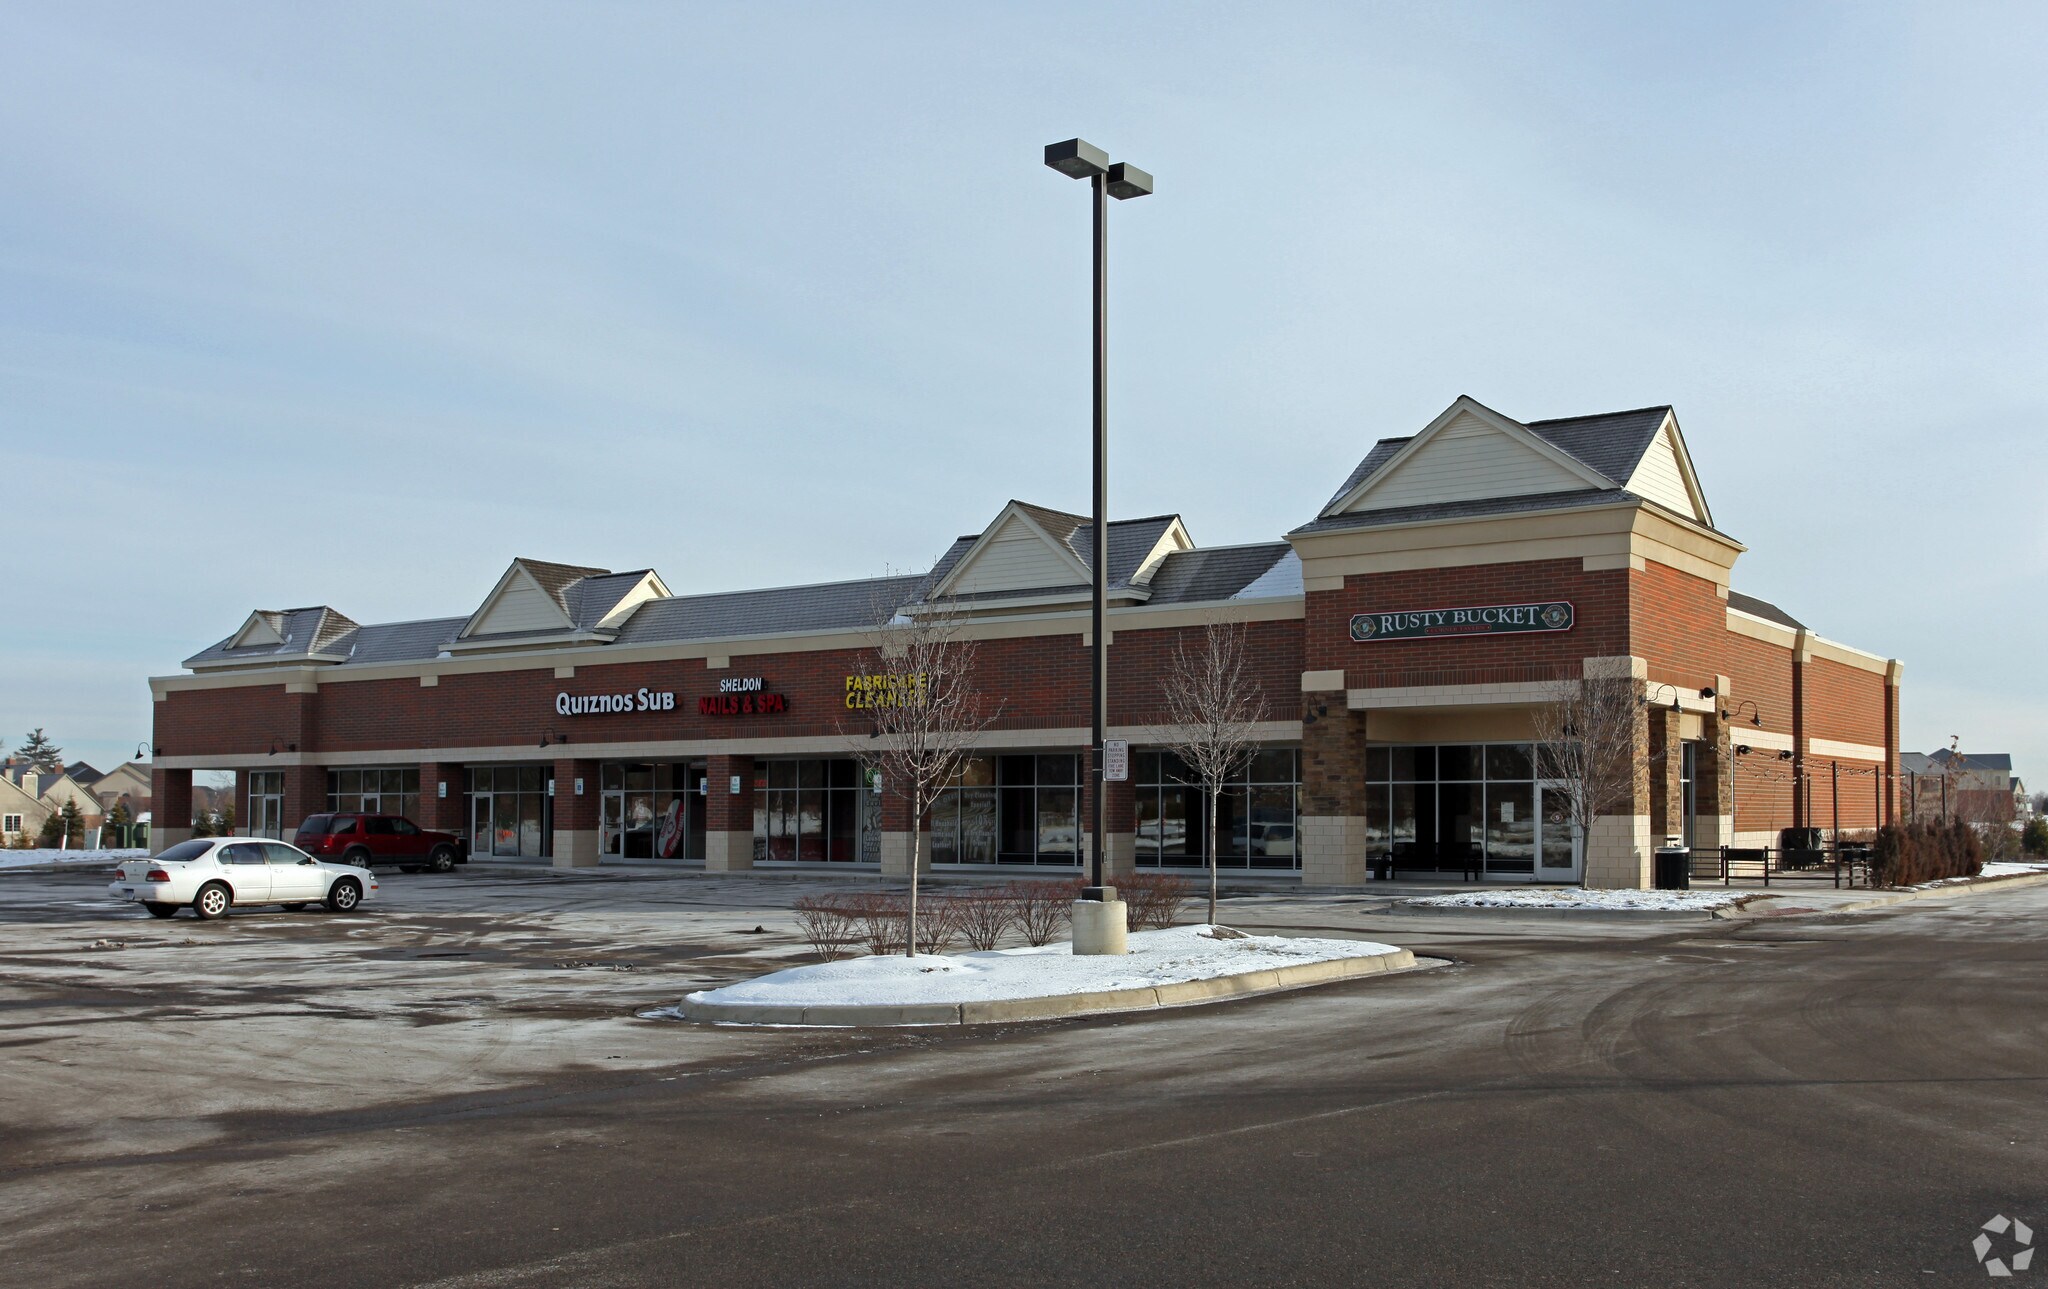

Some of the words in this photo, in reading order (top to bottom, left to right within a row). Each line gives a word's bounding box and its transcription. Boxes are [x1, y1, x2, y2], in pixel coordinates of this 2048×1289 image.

[1380, 611, 1447, 634] RUSTY
[1453, 606, 1539, 625] BUCKET
[720, 677, 762, 692] SHELDON
[699, 695, 739, 715] NAILS
[743, 694, 753, 714] &
[757, 693, 784, 713] SPA
